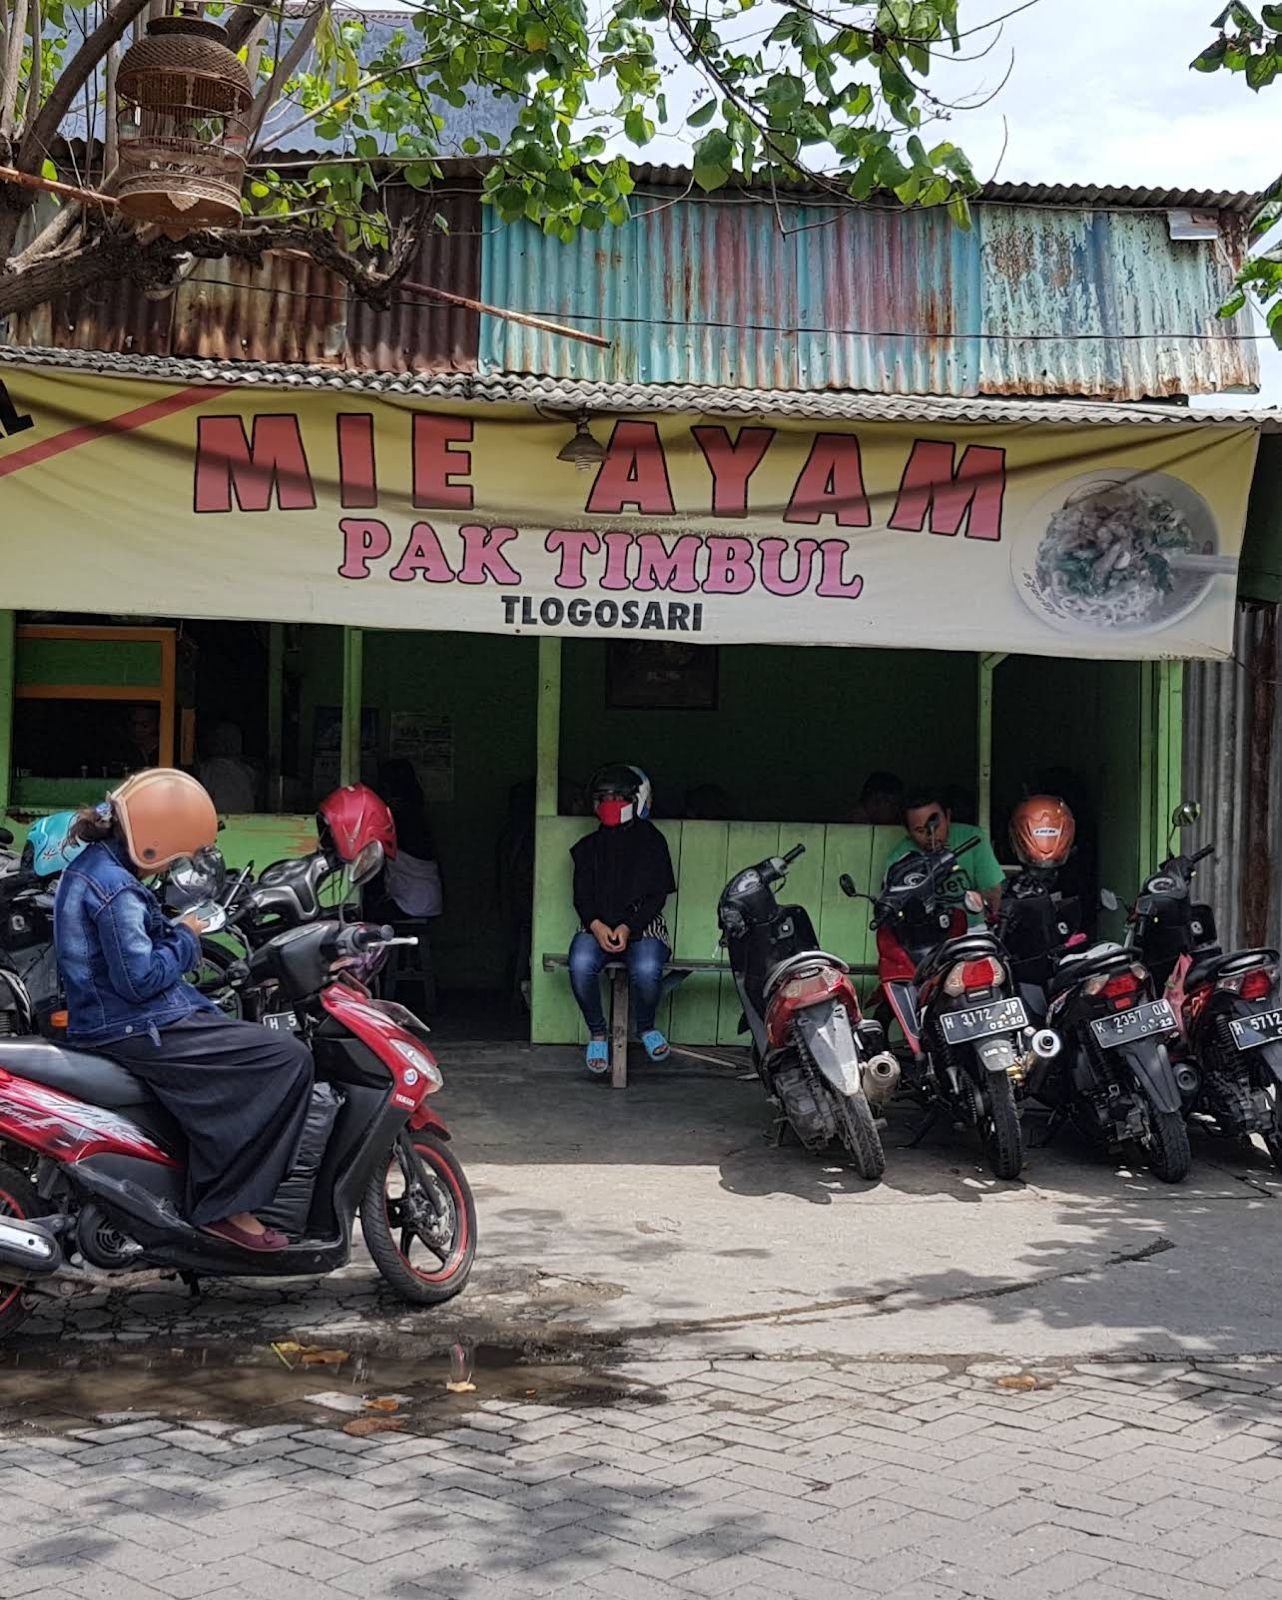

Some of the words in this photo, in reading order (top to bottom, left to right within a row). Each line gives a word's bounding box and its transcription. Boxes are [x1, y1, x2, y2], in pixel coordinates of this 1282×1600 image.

[193, 412, 474, 513] MIE
[585, 419, 1007, 542] AYAM
[338, 518, 522, 586] PAK
[545, 528, 864, 599] TIMBUL
[501, 595, 703, 632] TLOGOSARI
[269, 1017, 279, 1030] H
[943, 1017, 955, 1030] H
[960, 1009, 994, 1026] 3172
[1004, 1001, 1019, 1016] JP
[1096, 1022, 1107, 1034] K
[1113, 1010, 1143, 1029] 2357
[1250, 1012, 1282, 1030] 5712
